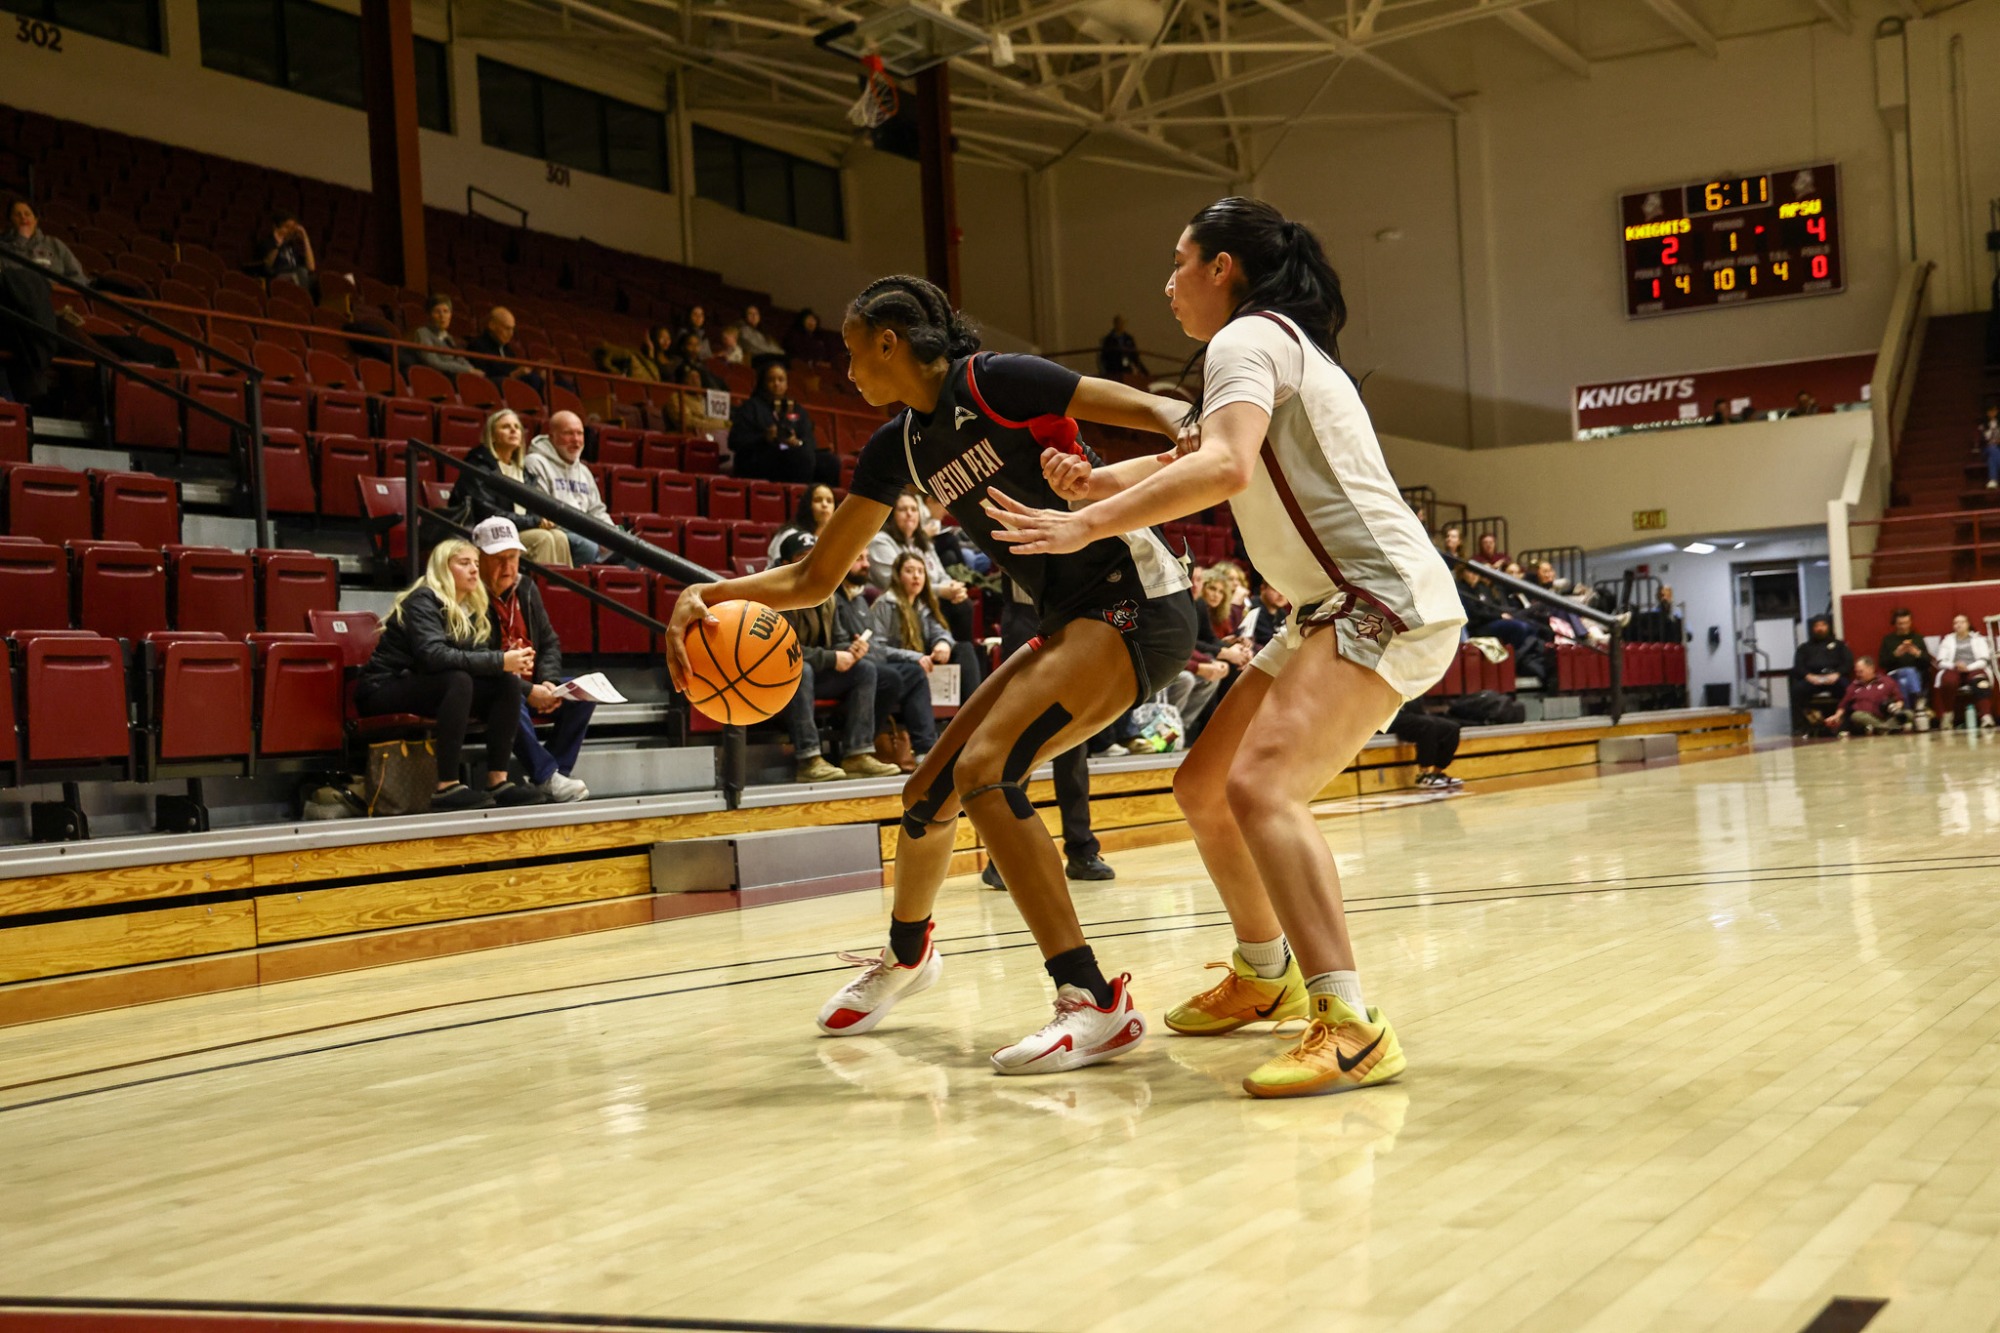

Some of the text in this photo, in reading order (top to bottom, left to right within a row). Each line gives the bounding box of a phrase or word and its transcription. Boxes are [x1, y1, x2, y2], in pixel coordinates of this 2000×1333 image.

[15, 16, 62, 53] 302
[546, 163, 571, 188] 301
[1704, 176, 1768, 211] 6:11
[1625, 217, 1691, 241] KNIGHTS
[1806, 217, 1826, 242] 4
[1661, 236, 1679, 265] 2
[1729, 231, 1738, 252] 1
[1750, 266, 1758, 285] 1
[1773, 261, 1789, 281] 4
[1811, 254, 1828, 279] 0
[1652, 278, 1661, 299] 1
[1675, 274, 1691, 294] 4
[1713, 267, 1735, 291] 10
[1578, 377, 1695, 410] KNIGHTS
[710, 399, 727, 416] 102
[961, 437, 1005, 483] PEAY
[490, 525, 513, 540] USA
